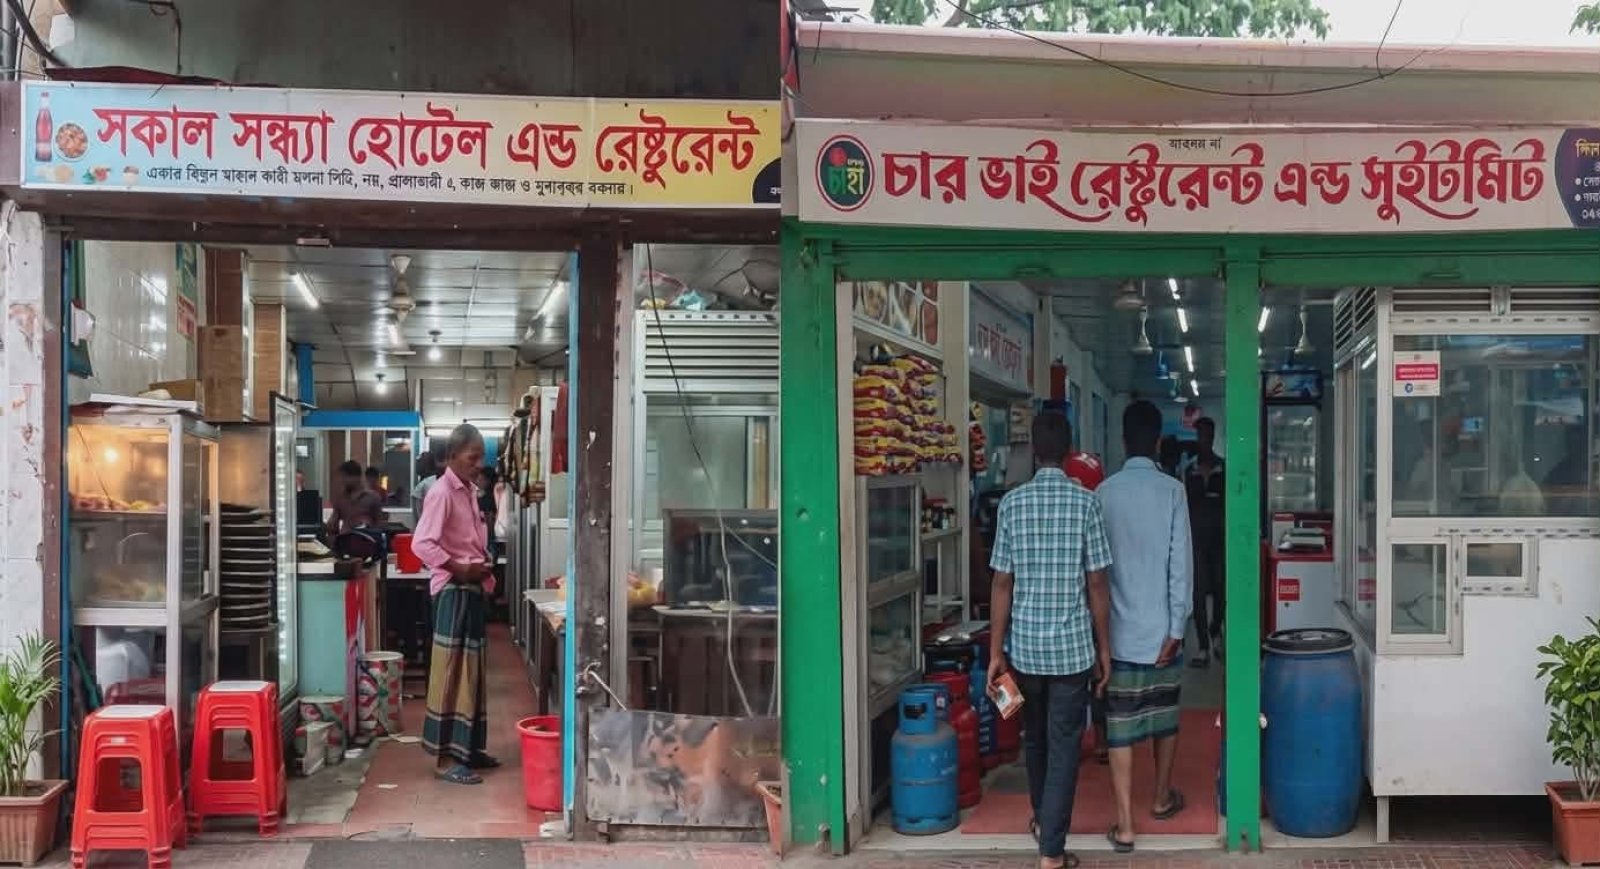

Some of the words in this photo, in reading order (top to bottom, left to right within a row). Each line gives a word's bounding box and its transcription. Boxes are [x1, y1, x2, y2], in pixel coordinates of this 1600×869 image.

[94, 104, 218, 160] সকাল
[230, 110, 335, 165] সন্ধ্যা
[348, 102, 494, 171] হোটেল
[506, 122, 582, 171] এন্ড
[595, 109, 760, 189] রেষ্টুরেন্ট
[881, 151, 969, 204] চার
[978, 139, 1111, 223] ভাই
[1070, 141, 1265, 228] রেস্টুরেন্ট
[1274, 160, 1352, 206] এন্ড
[1361, 137, 1546, 225] সুইটমিট
